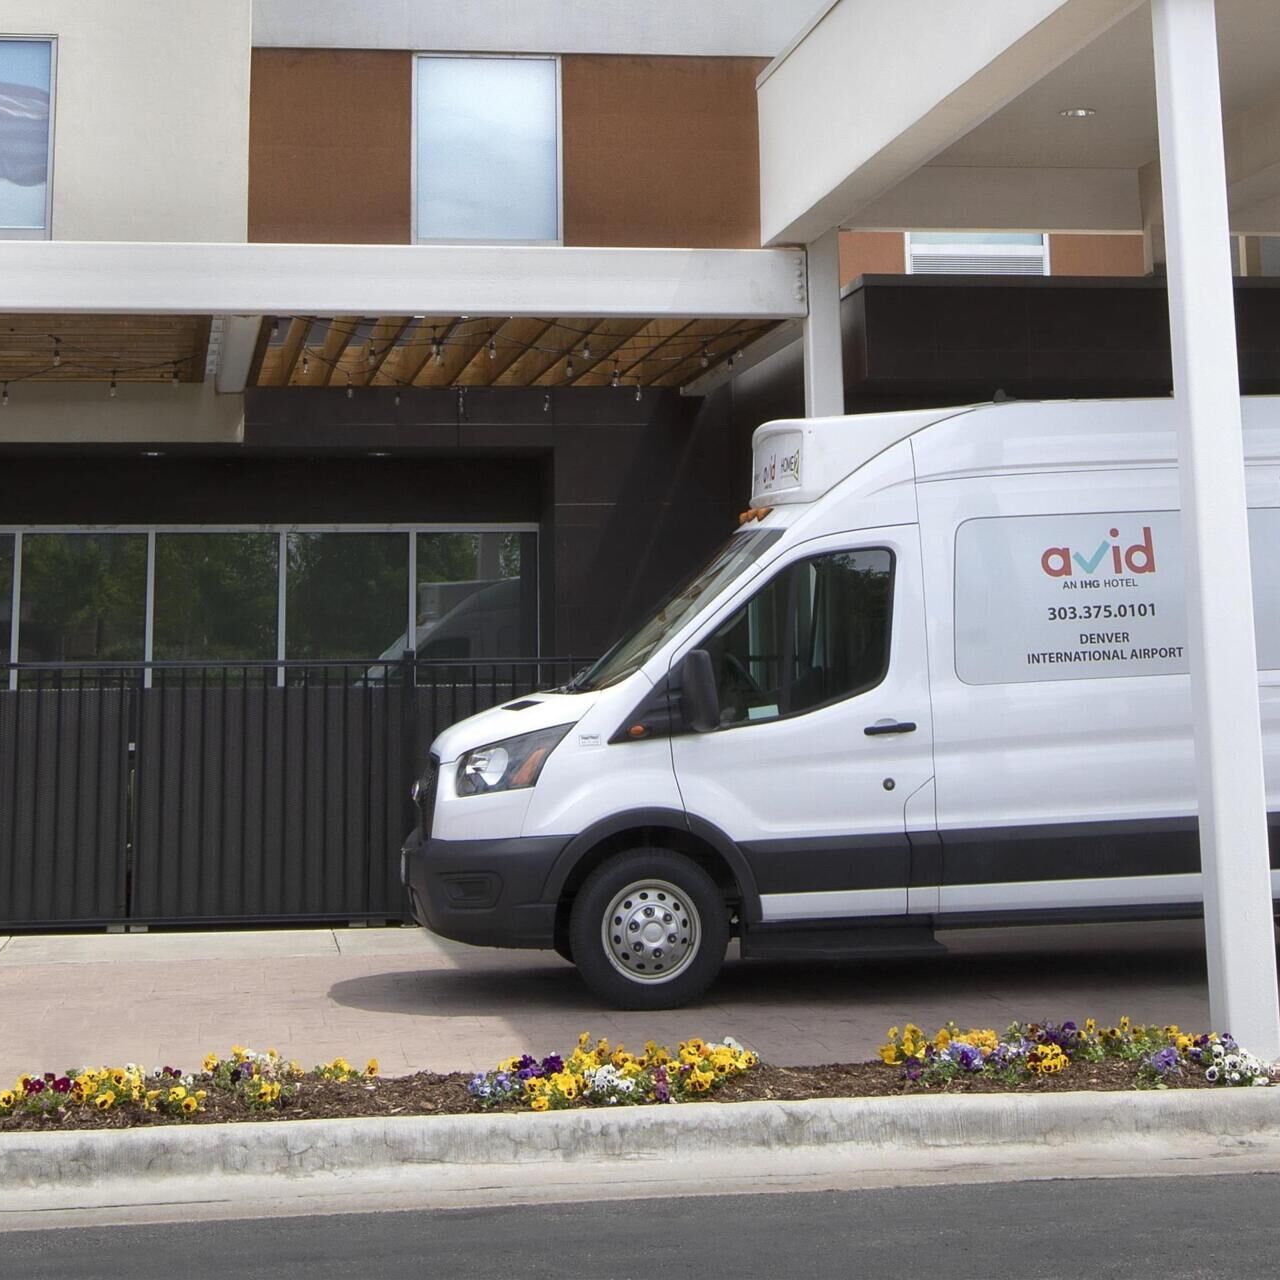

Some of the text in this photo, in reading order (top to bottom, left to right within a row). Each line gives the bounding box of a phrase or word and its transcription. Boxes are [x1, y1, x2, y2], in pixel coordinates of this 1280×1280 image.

[1041, 526, 1156, 577] avid
[1062, 578, 1138, 589] AN IHG HOTEL
[1048, 603, 1156, 621] 303.375.0101
[1080, 632, 1130, 645] DENVER
[1027, 646, 1184, 664] INTERNATIONAL AIRPORT
